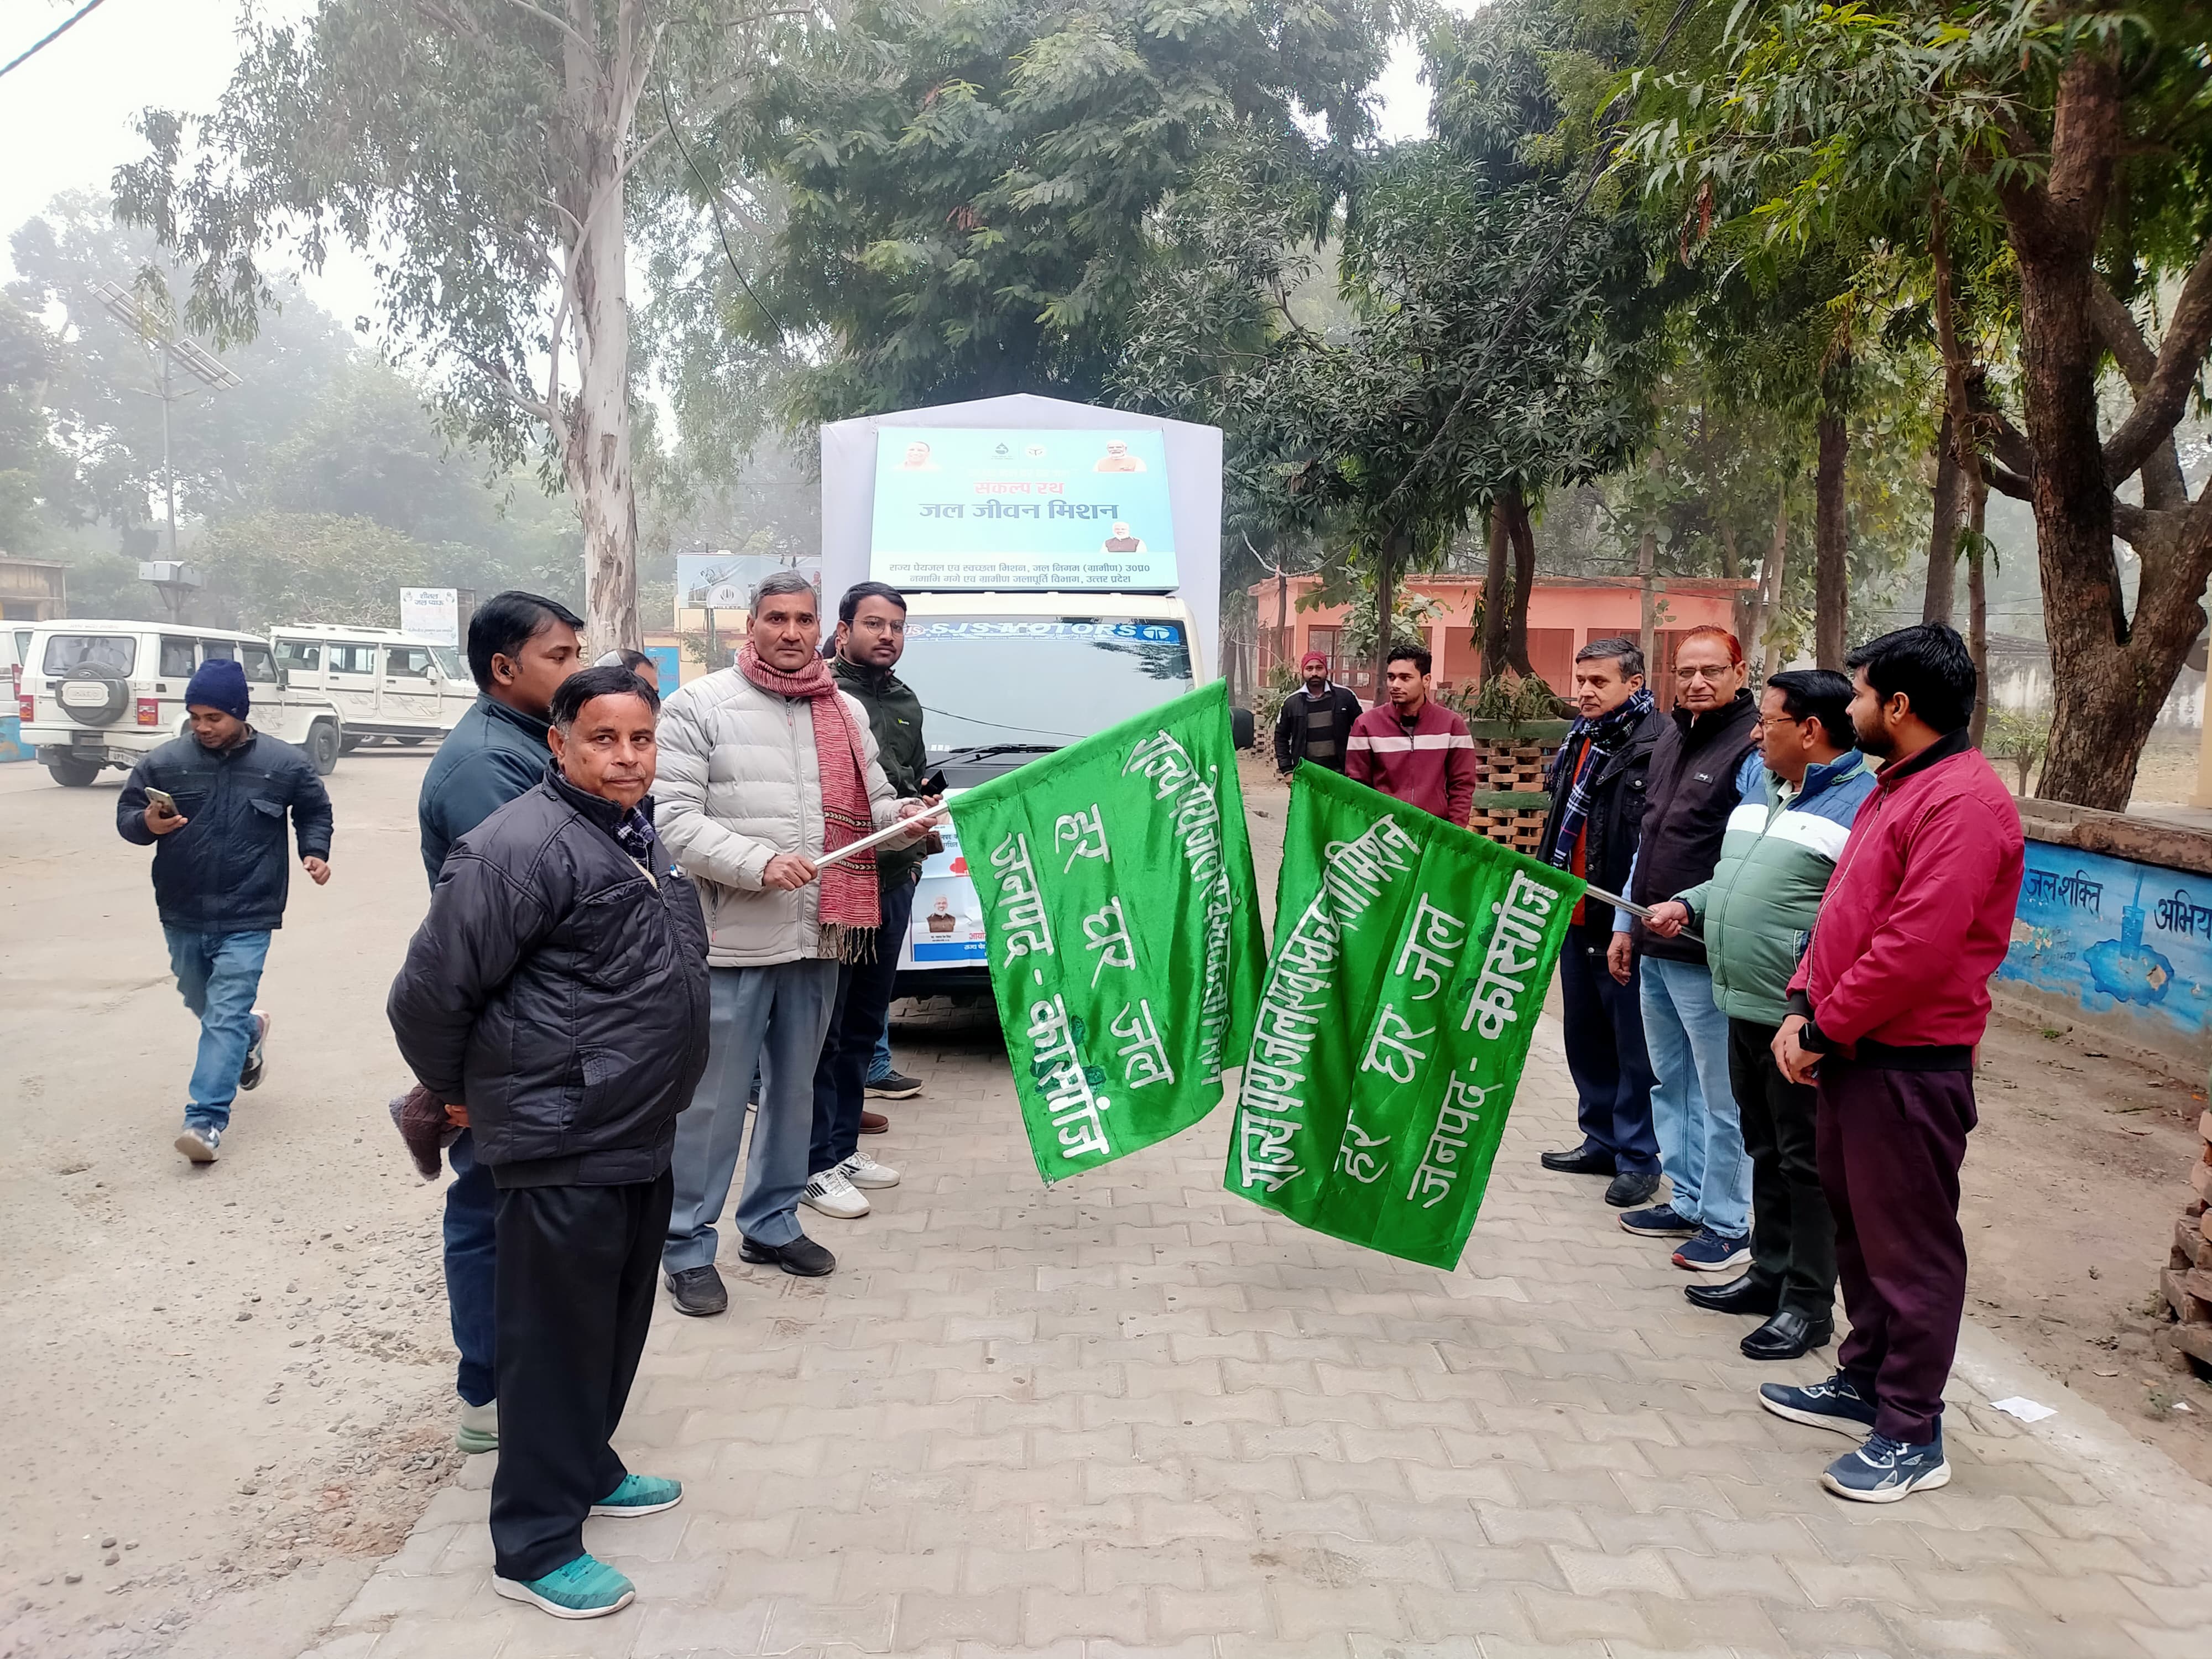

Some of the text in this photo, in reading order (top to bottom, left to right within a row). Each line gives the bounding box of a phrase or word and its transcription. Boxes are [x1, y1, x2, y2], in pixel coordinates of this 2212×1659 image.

[973, 479, 1065, 494] संकल्प रथ
[918, 499, 1120, 519] जल जीवन मिशन
[914, 562, 945, 572] पेयजल
[1052, 563, 1080, 572] निगम
[1083, 562, 1123, 572] (ग्रामीण)
[910, 573, 941, 582] नमामि
[943, 573, 961, 582] गंगे
[979, 573, 1010, 583] ग्रामीण
[1013, 573, 1048, 585] जलापूर्ति
[1110, 573, 1131, 583] प्रदेश
[998, 622, 1138, 637] MOTORS
[969, 930, 986, 940] आयो
[1054, 802, 1176, 1089] हर घर जल
[989, 831, 1054, 970] जनपद
[1026, 993, 1111, 1159] कासगंज
[1333, 891, 1467, 1185] हर घर जल
[1405, 1069, 1505, 1209] जनपद
[1460, 868, 1559, 1041] कासगंज
[1240, 1108, 1306, 1193] राज्य
